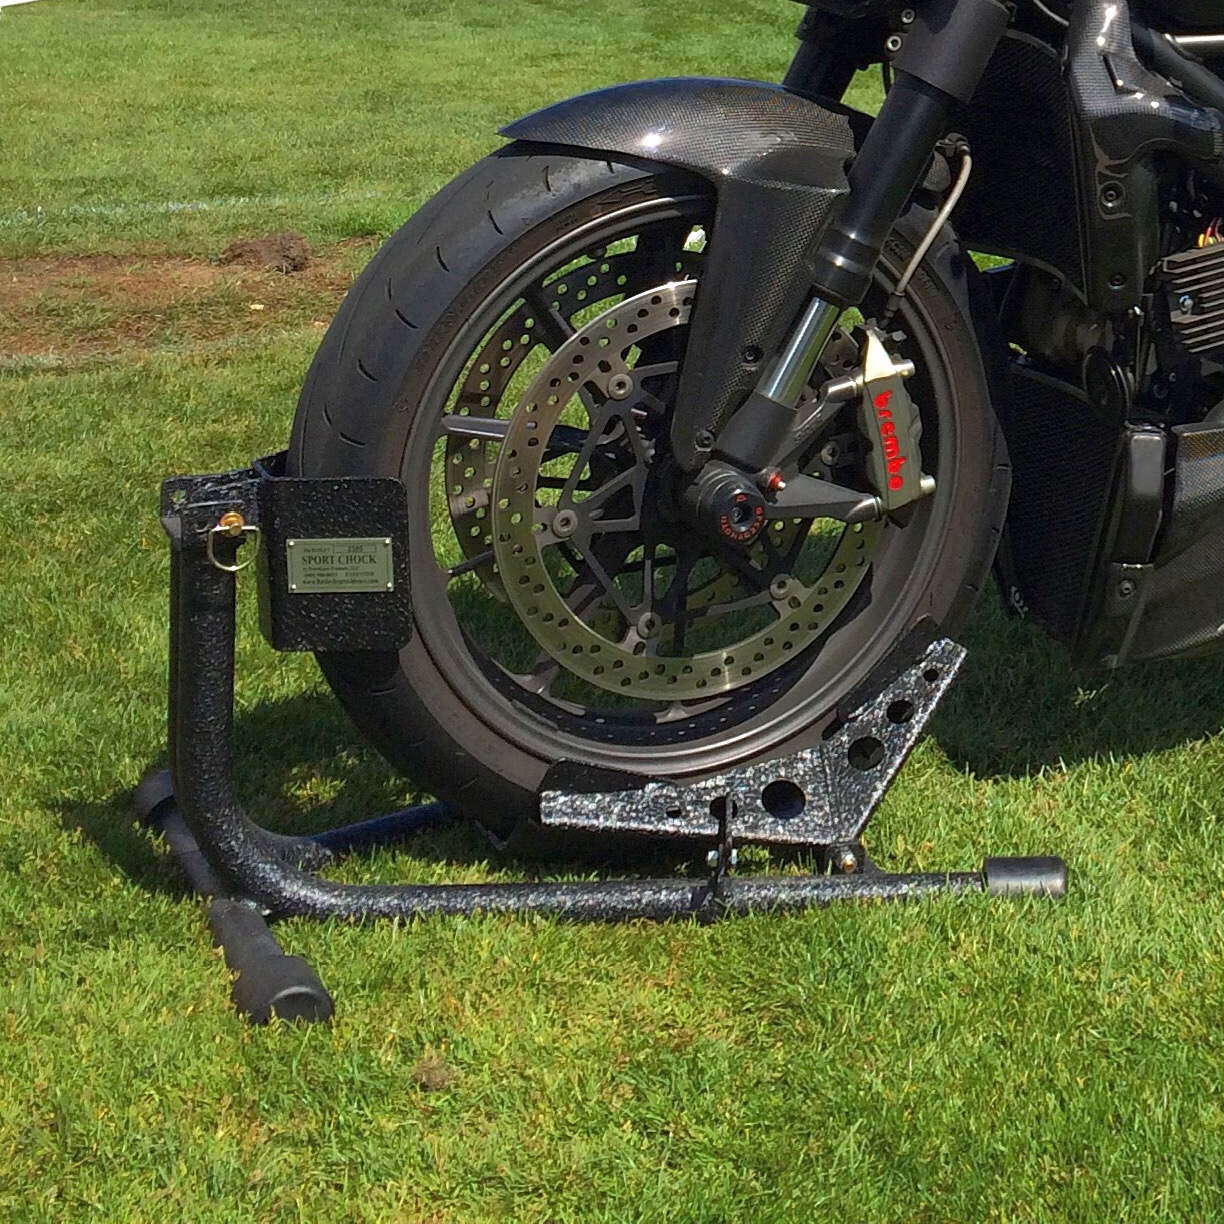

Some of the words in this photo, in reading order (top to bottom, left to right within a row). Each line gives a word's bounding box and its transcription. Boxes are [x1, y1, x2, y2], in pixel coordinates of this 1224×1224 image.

[873, 389, 907, 491] brembo
[301, 555, 335, 565] SPORT
[338, 554, 377, 564] CHOCK
